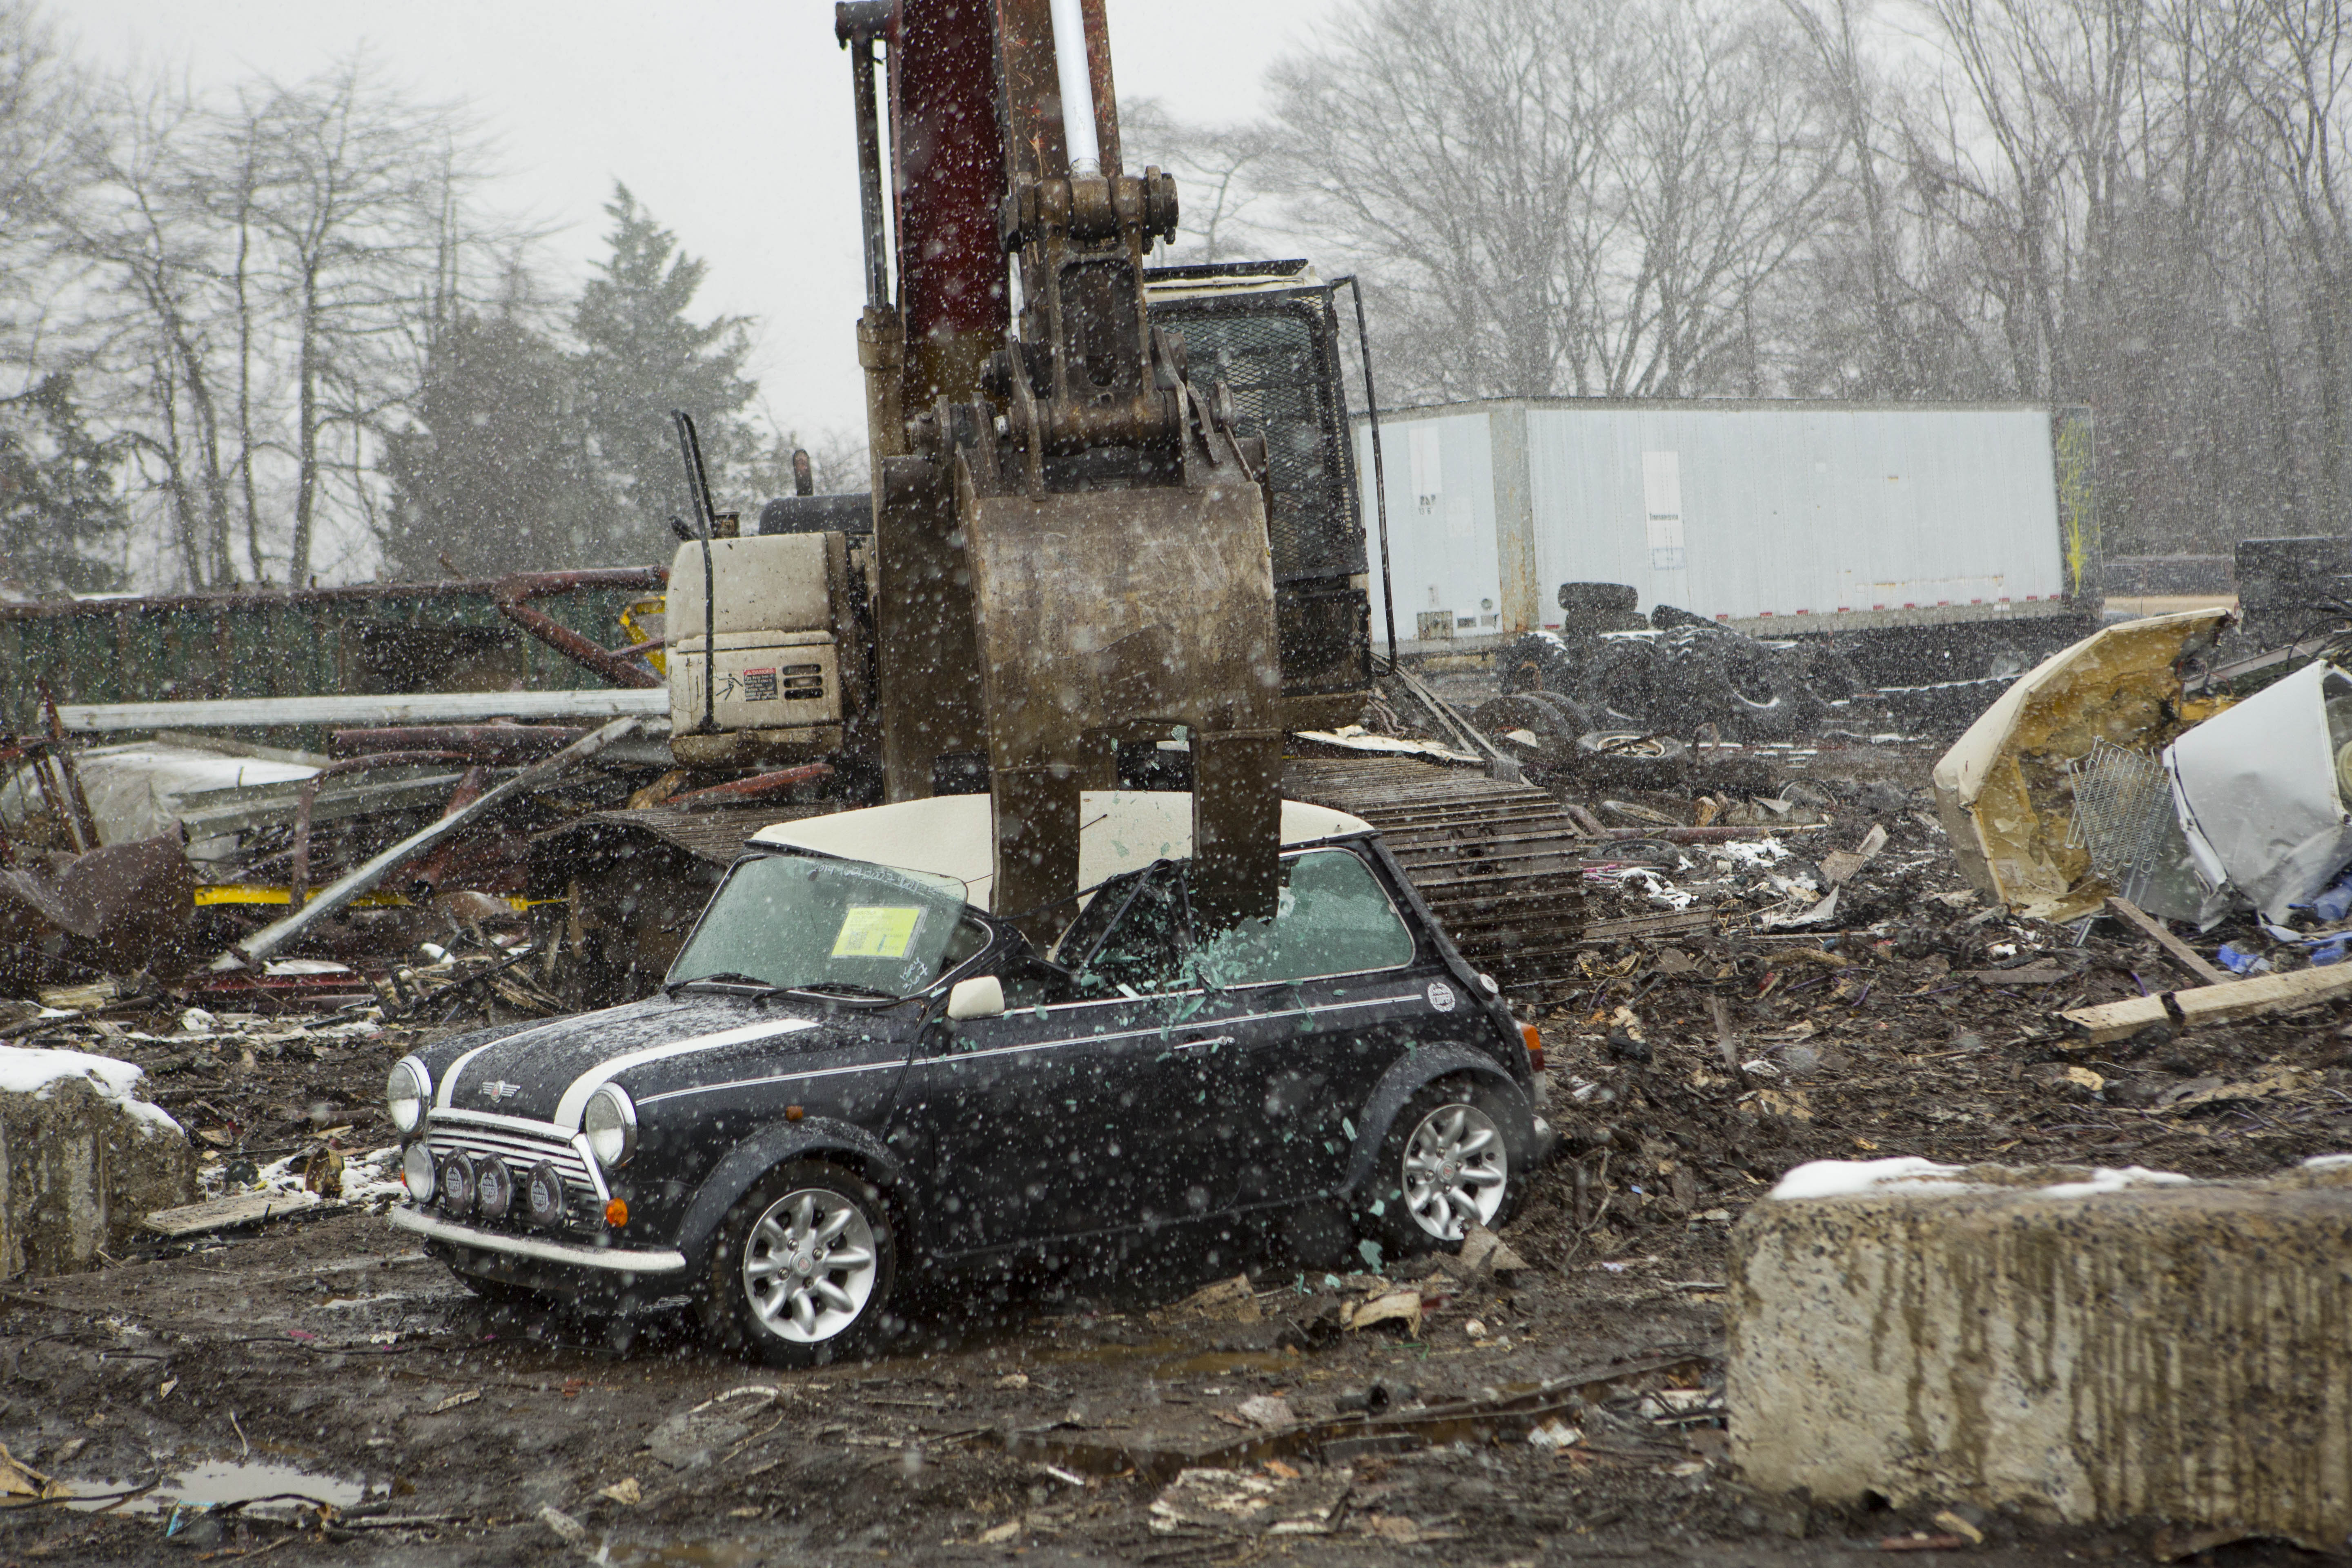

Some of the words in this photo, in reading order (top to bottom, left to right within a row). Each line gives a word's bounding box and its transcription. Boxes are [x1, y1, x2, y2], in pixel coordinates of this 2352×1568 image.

[449, 1173, 458, 1181] MINI
[483, 1178, 493, 1187] MINI
[532, 1186, 543, 1195] MINI
